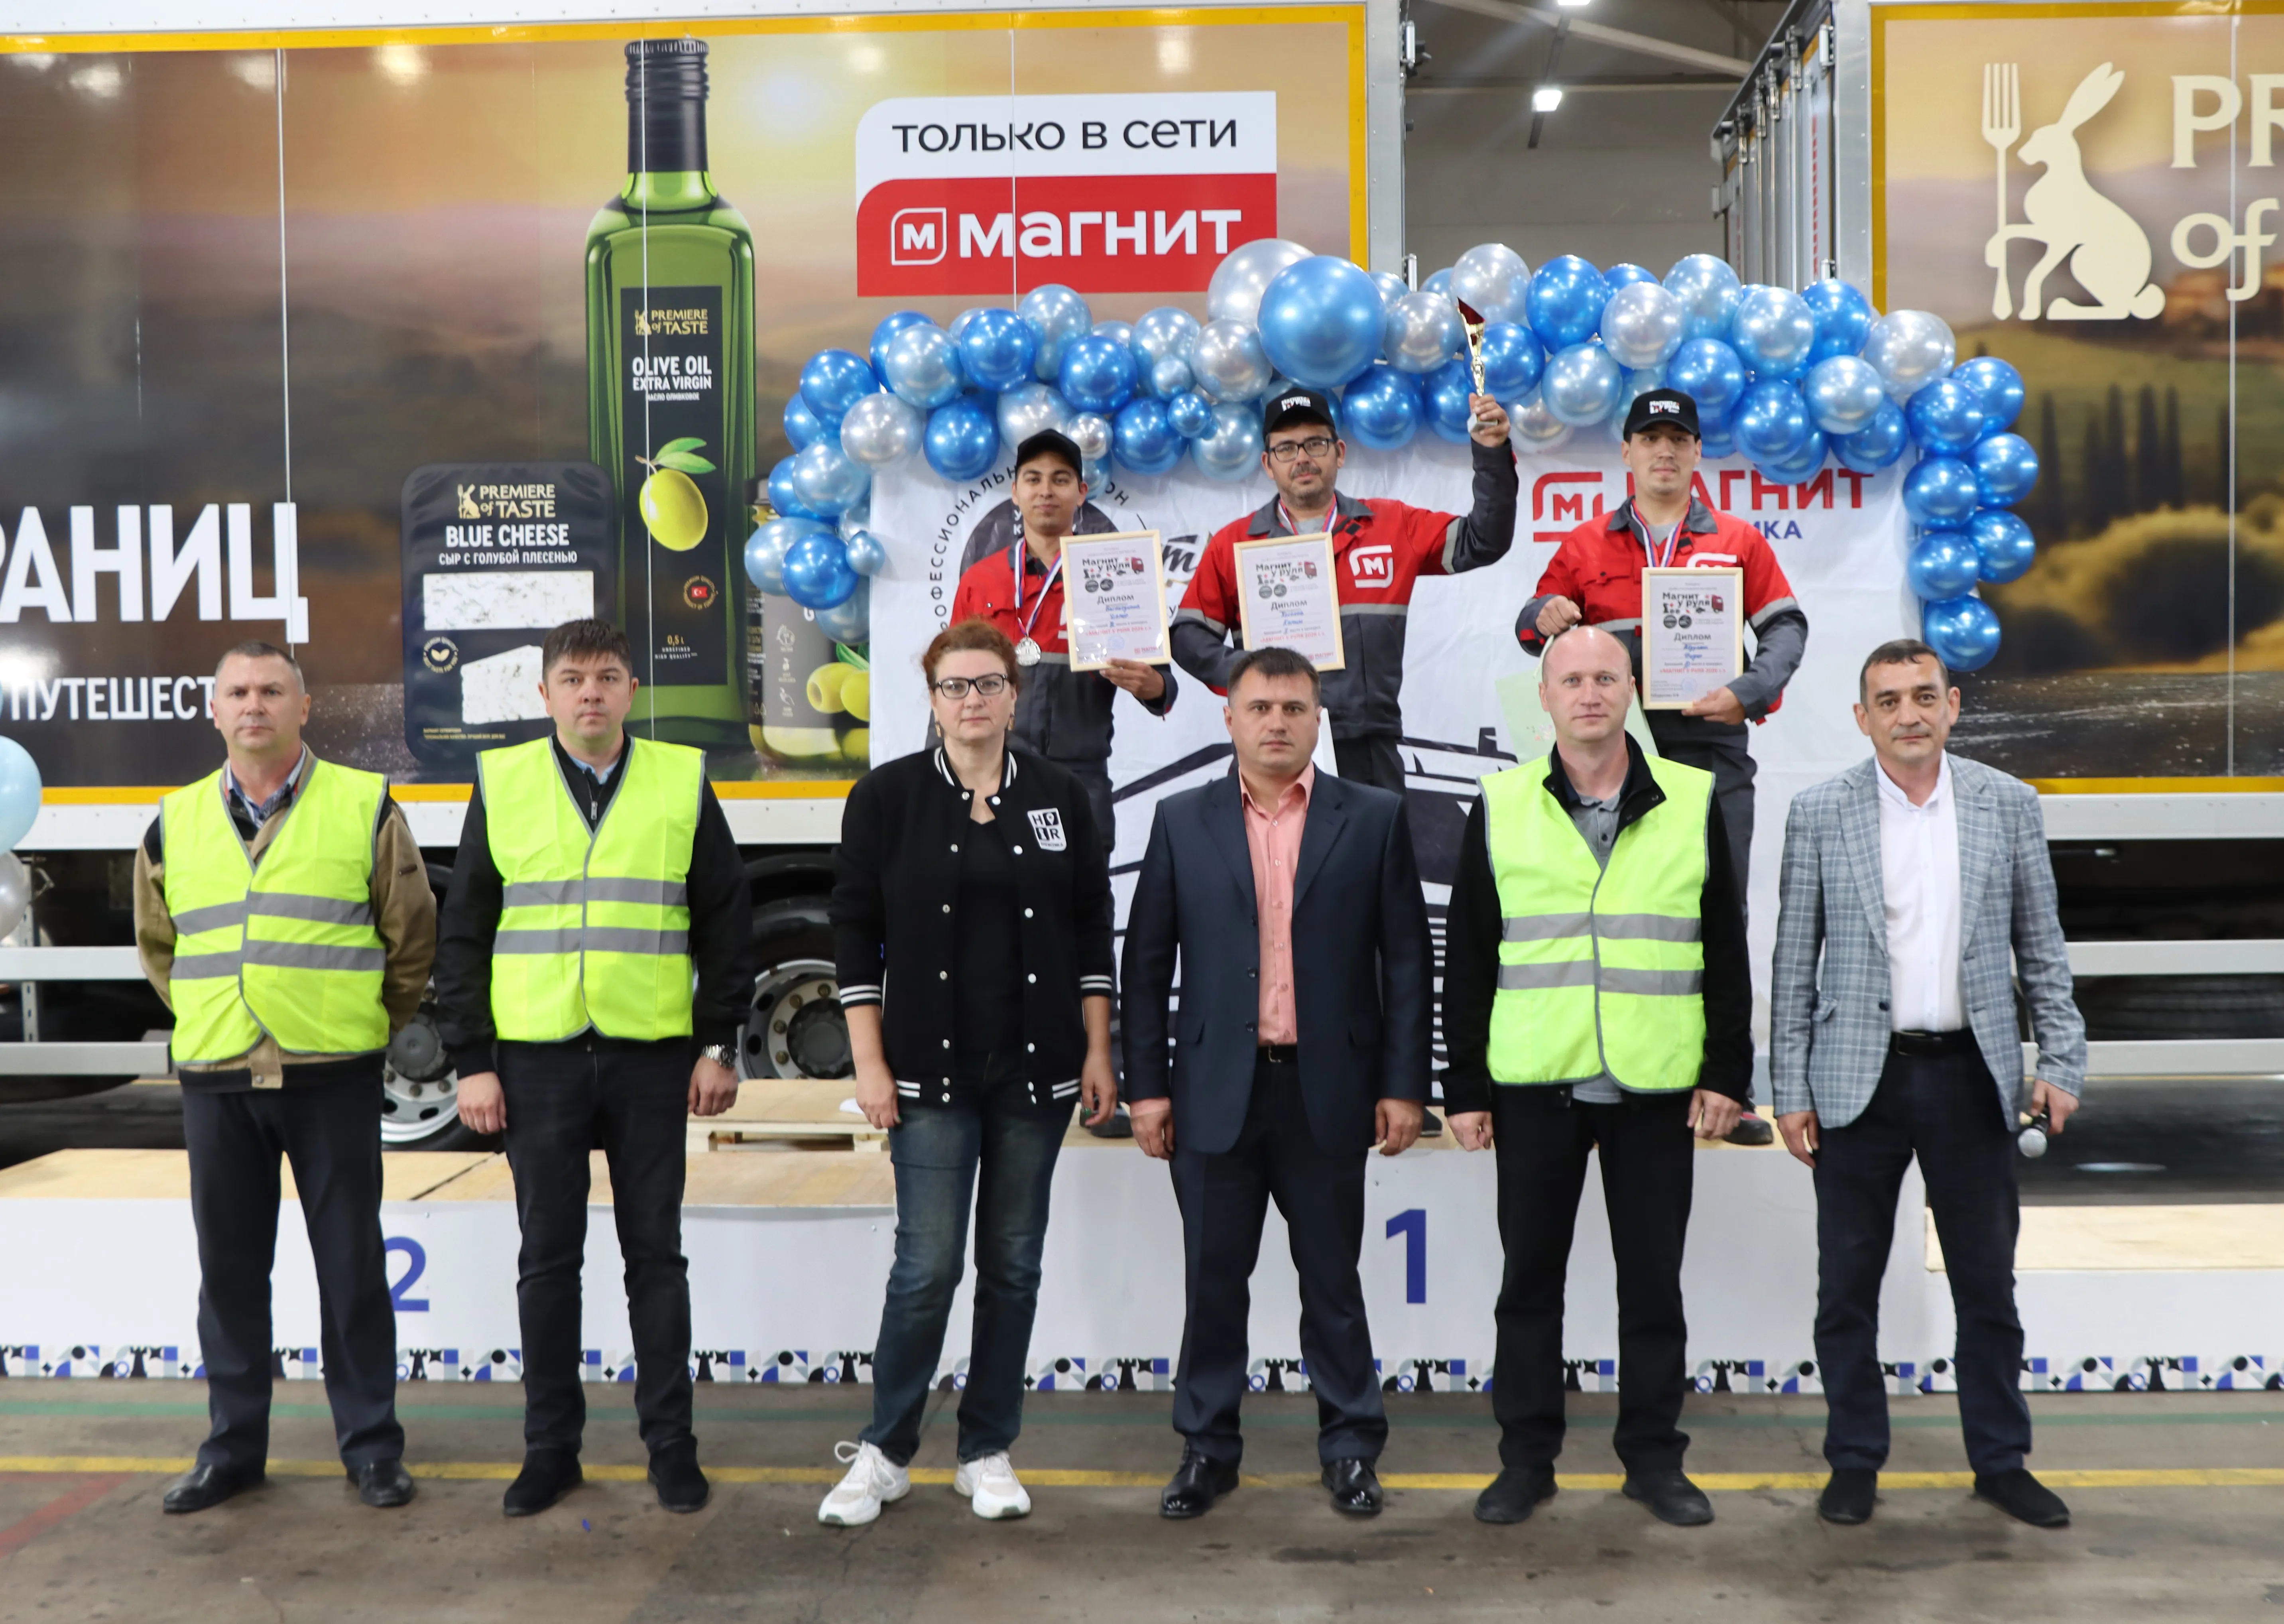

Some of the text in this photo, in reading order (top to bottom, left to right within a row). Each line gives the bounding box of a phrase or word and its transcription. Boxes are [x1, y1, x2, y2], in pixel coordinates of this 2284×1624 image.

[2170, 197, 2280, 301] of
[651, 309, 708, 321] PREMIERE
[652, 321, 708, 335] of TASTE
[632, 355, 712, 376] OLIVE OIL
[633, 376, 712, 391] EXTRA VIRGIN
[480, 484, 556, 500] PREMIERE
[1627, 468, 1875, 511] АГНИТ
[480, 500, 556, 518] of TASTE
[446, 524, 570, 548] BLUE CHEESE
[930, 464, 1017, 632] РОФЕССИОНАЛЬН
[439, 553, 462, 566] СЫР
[473, 548, 520, 565] ГОЛУБОЙ
[523, 550, 578, 564] ПЛЕСЕНЬЮ
[0, 502, 309, 644] АНИЦ
[10, 676, 216, 720] ПУТЕШЕСТ
[1386, 1209, 1426, 1304] 1
[383, 1236, 430, 1312] 2
